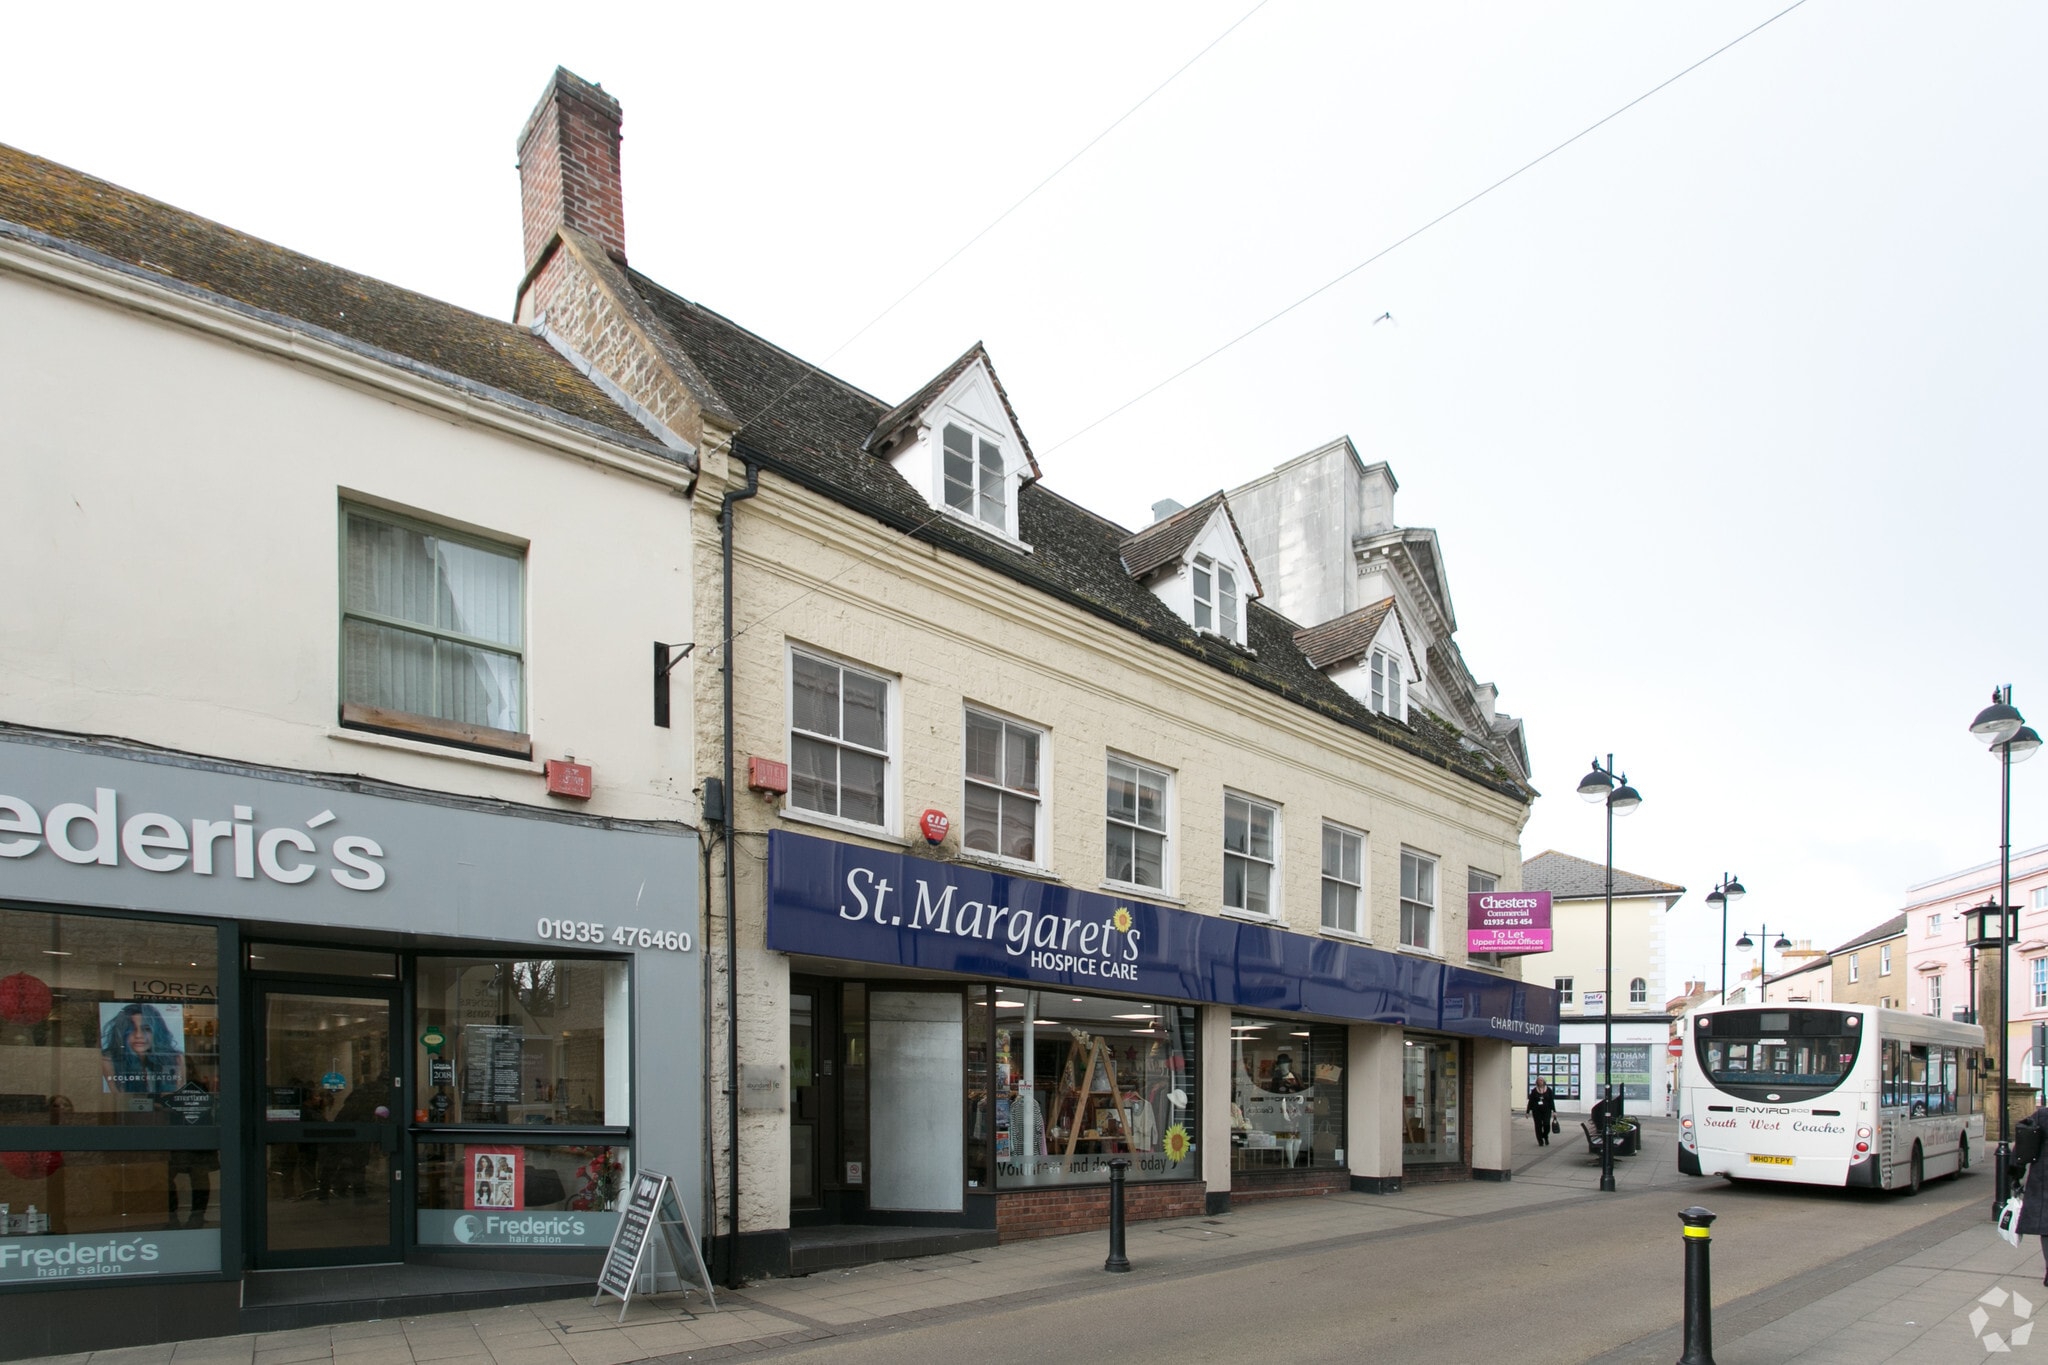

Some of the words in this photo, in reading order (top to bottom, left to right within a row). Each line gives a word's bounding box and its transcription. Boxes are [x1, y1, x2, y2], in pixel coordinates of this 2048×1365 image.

[927, 814, 948, 826] CID
[840, 867, 900, 926] St.
[1480, 895, 1537, 909] Chesters
[1487, 909, 1529, 917] Commercial
[1483, 918, 1504, 926] 01935
[1505, 918, 1518, 926] 415
[1519, 918, 1533, 926] 454
[537, 917, 604, 944] 01935
[611, 926, 692, 951] 476460
[1491, 930, 1506, 939] To
[1508, 930, 1525, 939] Let
[1496, 938, 1516, 946] Floor
[1517, 937, 1544, 946] Offices
[1031, 950, 1097, 976] HOSPICE
[1100, 960, 1138, 981] CARE
[1490, 1016, 1523, 1033] CHARITY
[1524, 1022, 1545, 1036] SHOP
[1600, 1052, 1646, 1060] WNDHAM
[1612, 1060, 1635, 1068] PARK
[433, 1071, 451, 1079] 2018
[1703, 1116, 1738, 1129] South
[1749, 1119, 1781, 1131] West
[1793, 1121, 1846, 1134] Coaches
[1775, 1157, 1791, 1165] EPY
[509, 1234, 528, 1243] hair
[533, 1234, 561, 1244] salon
[37, 1265, 70, 1277] hair
[77, 1264, 122, 1275] salon
